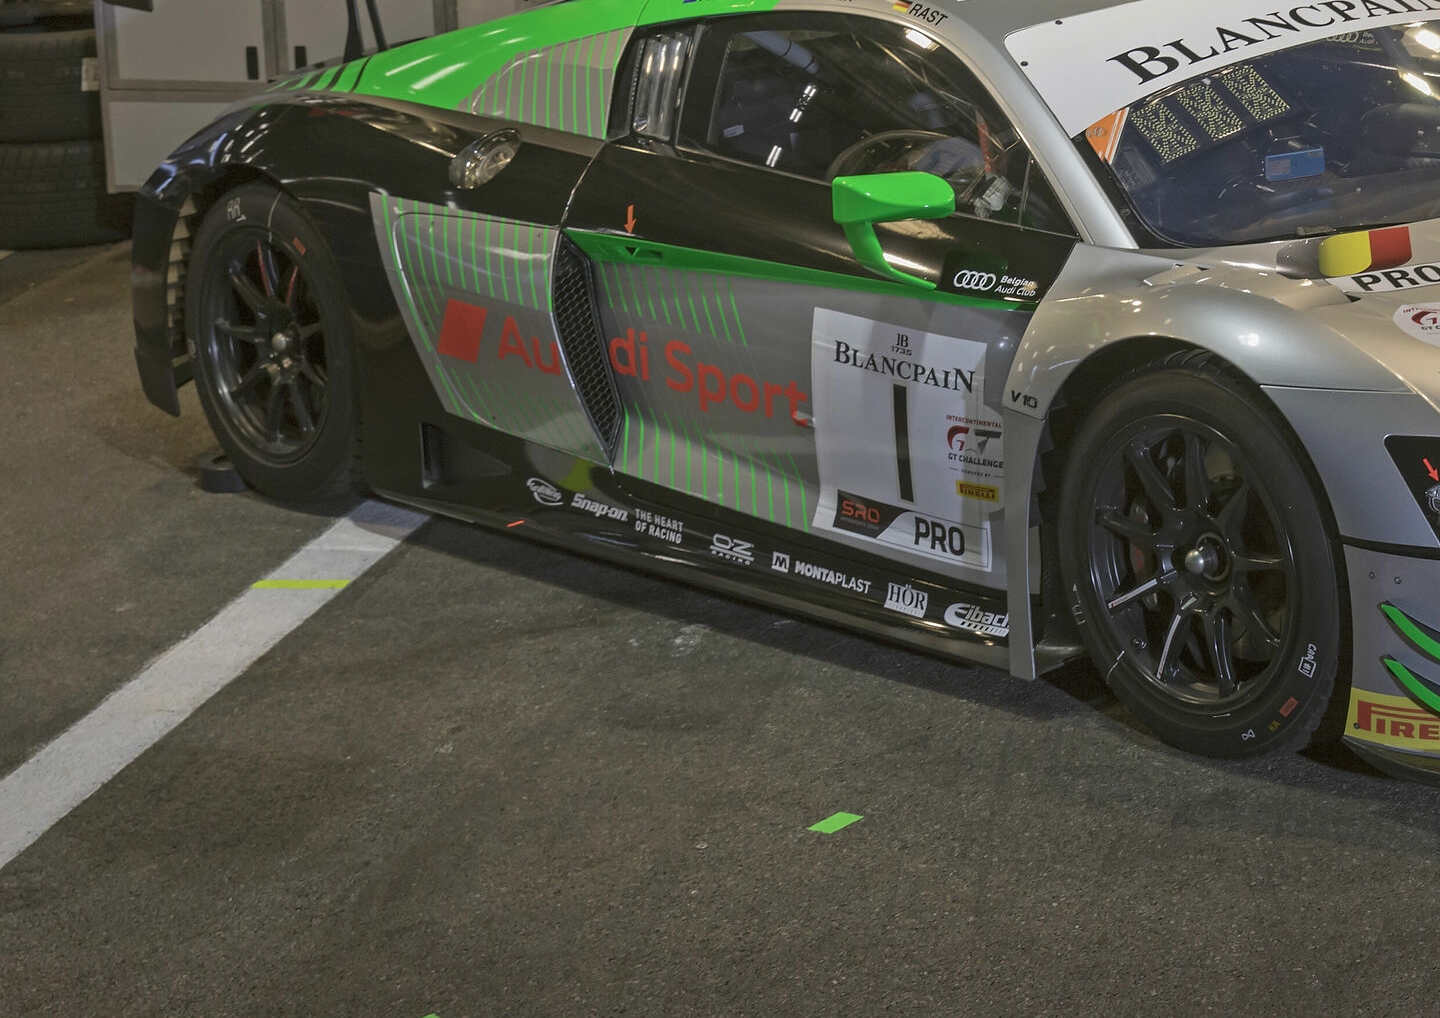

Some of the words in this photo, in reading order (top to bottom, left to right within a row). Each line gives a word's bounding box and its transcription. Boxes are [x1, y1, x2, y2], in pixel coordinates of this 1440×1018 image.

[909, 3, 949, 27] RAST
[995, 285, 1015, 295] Audi
[1016, 287, 1037, 297] Club
[1000, 275, 1035, 287] Belgian
[500, 315, 649, 381] Audi
[665, 341, 808, 427] Sport
[834, 339, 975, 394] BLANCPAIN
[946, 414, 1002, 429] INTERCONTINENTAL
[893, 383, 915, 502] 1
[948, 453, 958, 462] GT
[959, 454, 1004, 469] CHALLENGE
[959, 484, 996, 500] PIRELLI
[571, 492, 628, 522] Snap-on
[841, 500, 881, 523] SRO
[635, 508, 652, 523] THE
[654, 514, 684, 533] HEART
[635, 520, 646, 533] OF
[649, 523, 682, 545] RACING
[914, 516, 966, 556] PRO
[711, 549, 751, 566] RACING
[794, 560, 871, 595] MONTAPLAST
[887, 582, 927, 612] HÖR
